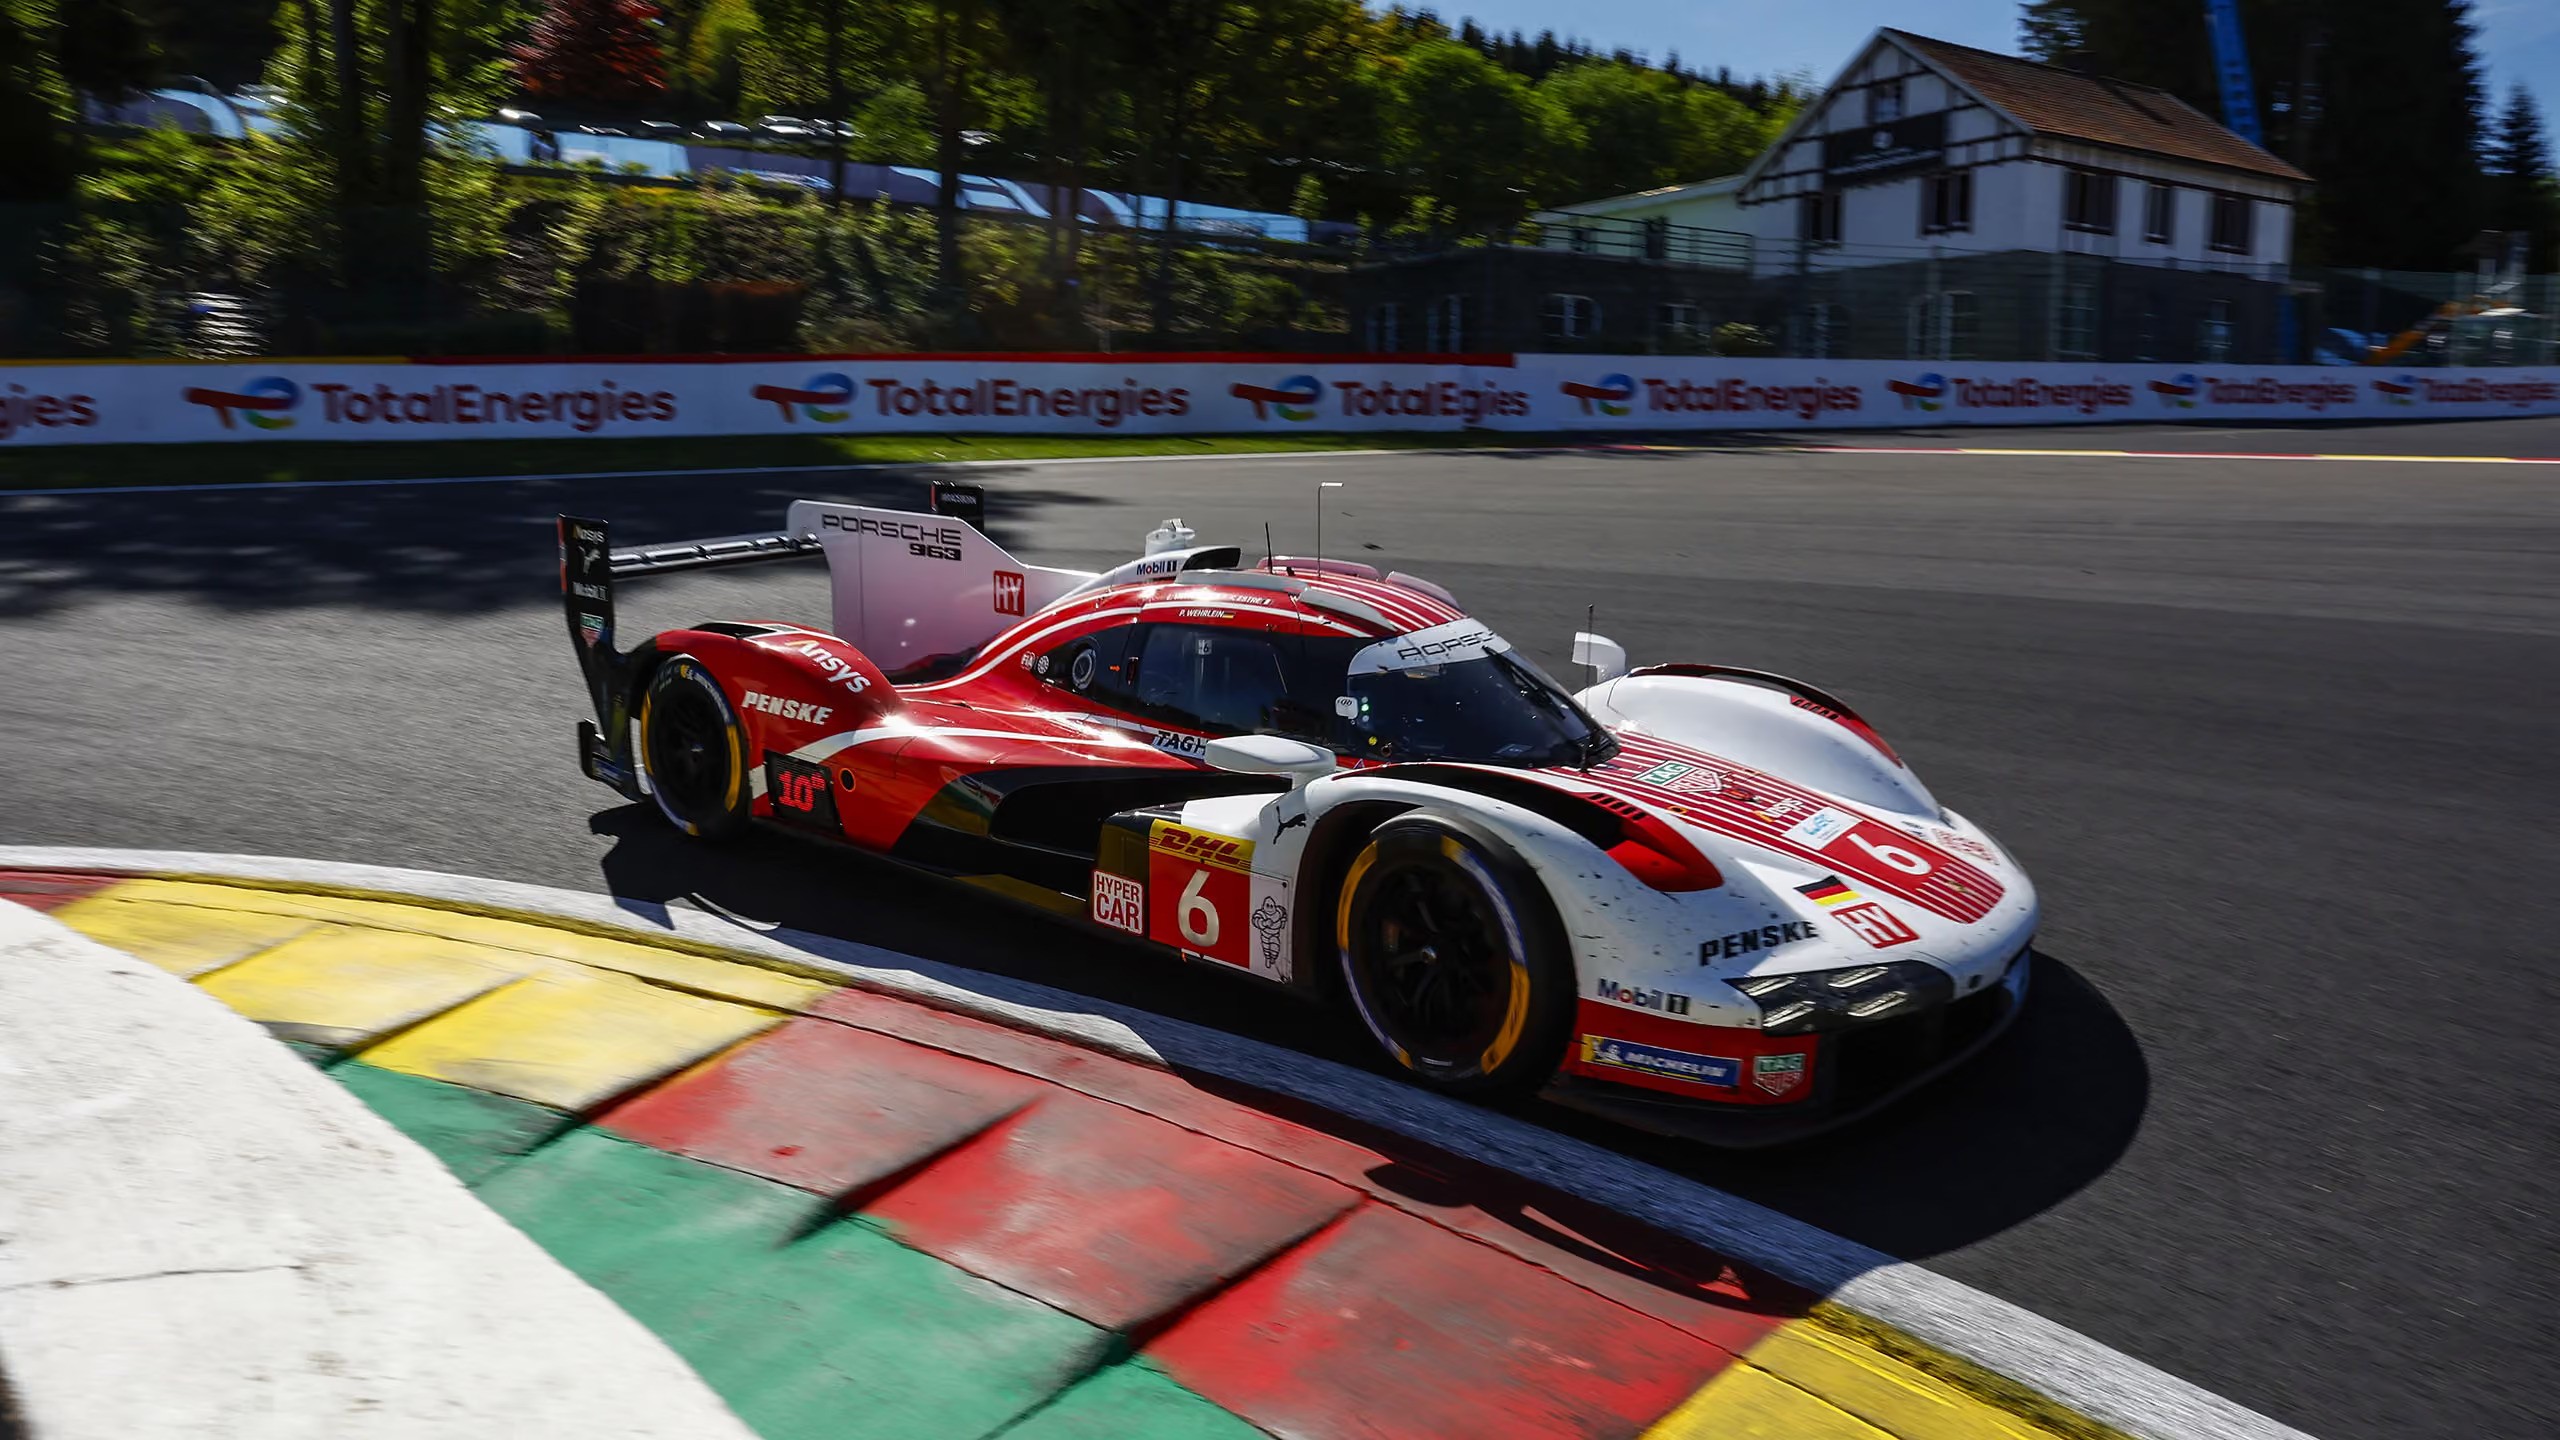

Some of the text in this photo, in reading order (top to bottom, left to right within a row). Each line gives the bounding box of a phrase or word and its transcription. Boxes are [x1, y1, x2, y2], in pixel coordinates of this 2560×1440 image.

[310, 380, 677, 432] TotalEnergies
[865, 377, 1191, 427] TotalEnergies
[1642, 377, 1862, 420] TotalEnergies
[821, 513, 962, 546] PORSCHE
[909, 543, 962, 562] 963
[1136, 562, 1166, 576] Mobil
[994, 575, 1022, 612] HY
[1178, 609, 1225, 618] P. WEHRLEIN
[785, 640, 871, 694] Ansys
[742, 691, 833, 725] PENSKE
[1638, 763, 1692, 785] TAG
[1160, 828, 1241, 864] DHL
[1847, 833, 1932, 875] 6
[1096, 874, 1140, 902] HYPER
[1096, 894, 1139, 931] CAR
[1178, 869, 1219, 947] 6
[1834, 904, 1909, 947] HY
[1699, 921, 1818, 966] PENSKE
[1598, 978, 1664, 1010] Mobil
[1624, 1051, 1728, 1078] MICHELIN
